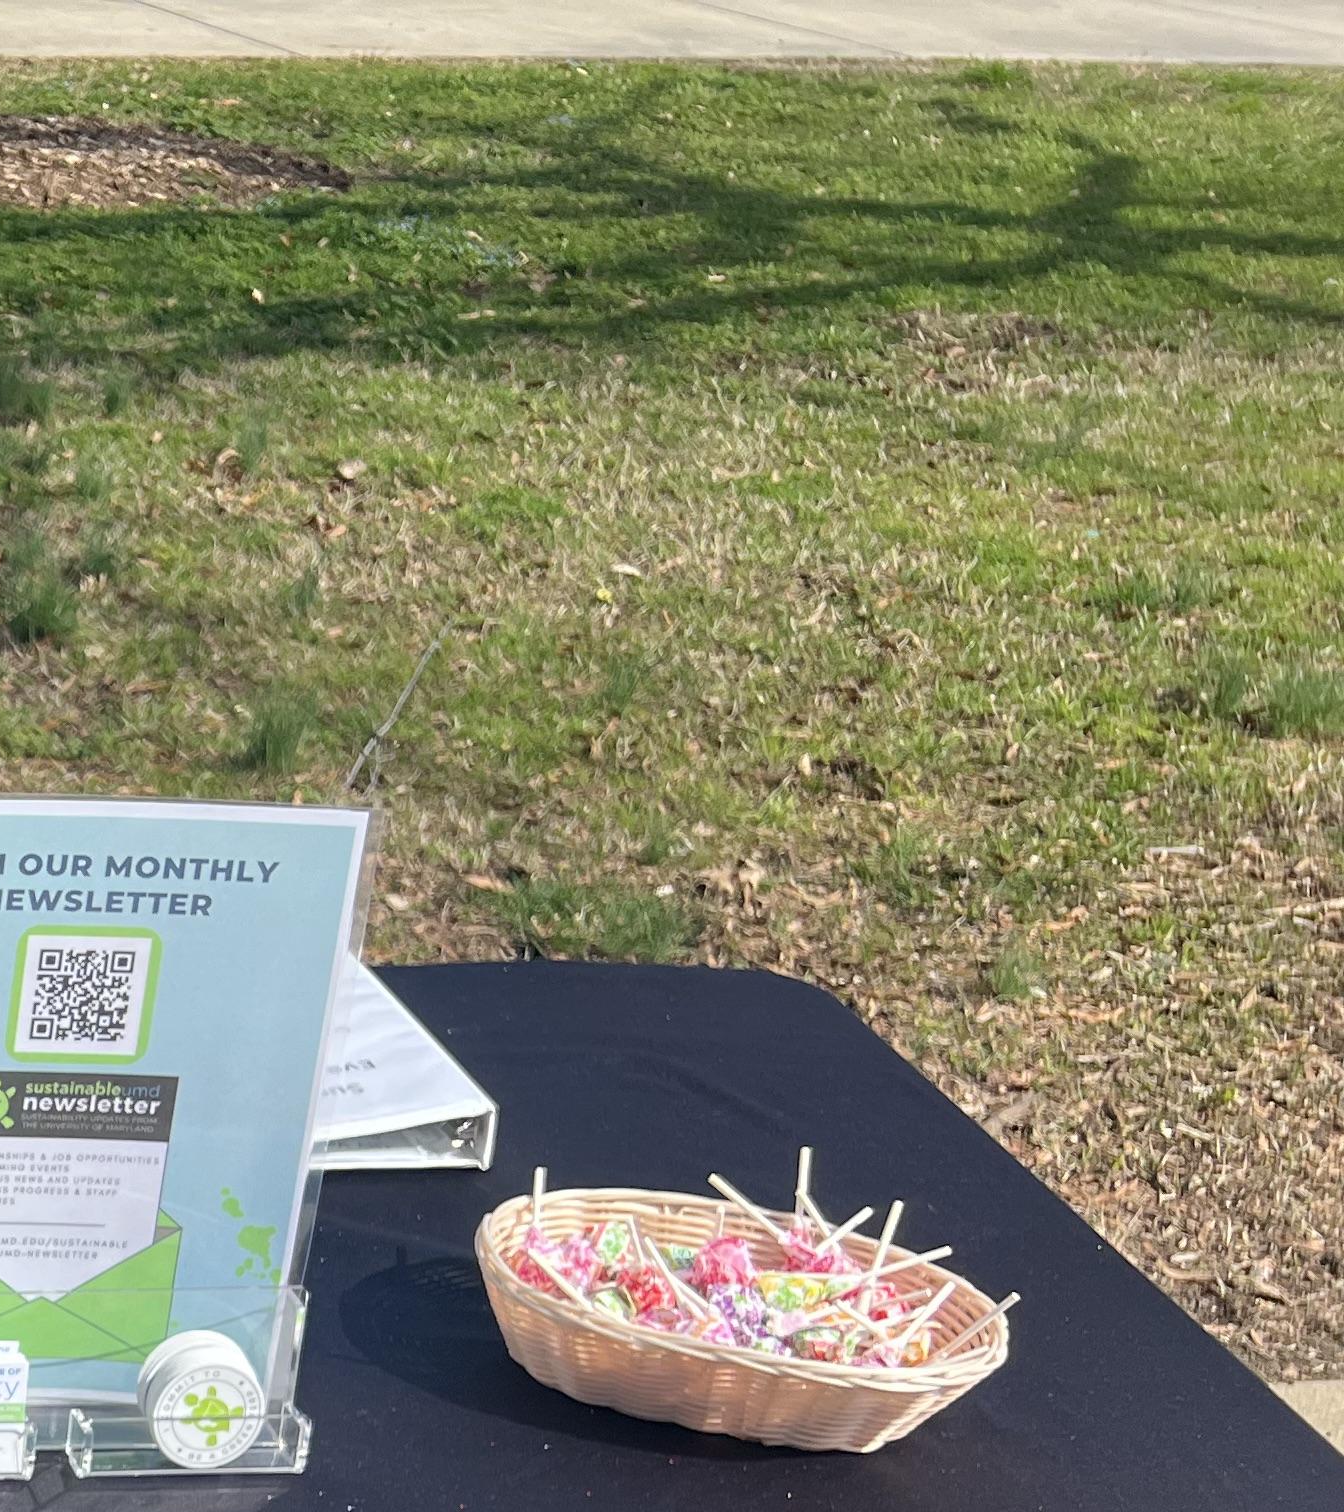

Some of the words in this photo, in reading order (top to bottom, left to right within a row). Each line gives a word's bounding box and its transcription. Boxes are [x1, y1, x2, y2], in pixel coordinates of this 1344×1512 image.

[18, 853, 93, 877] OUR
[103, 855, 281, 883] MONTHLY
[25, 1080, 161, 1098] sustainableumd
[22, 1094, 161, 1115] newsletter
[21, 1113, 87, 1122] SUSTAINABILITY
[91, 1115, 131, 1123] UPDATES
[133, 1116, 158, 1124] FROM
[22, 1121, 37, 1129] THE
[40, 1122, 90, 1130] UNIVERSITY
[106, 1124, 154, 1132] MARYLAND
[40, 1153, 46, 1161] &
[52, 1153, 71, 1161] JOB
[76, 1154, 160, 1165] OPPORTUNITIES
[30, 1164, 70, 1172] EVENTS
[47, 1176, 69, 1184] AND
[73, 1177, 120, 1185] UPDATES
[13, 1187, 70, 1195] PROGRESS
[74, 1188, 80, 1196] &
[8, 1368, 22, 1376] OF
